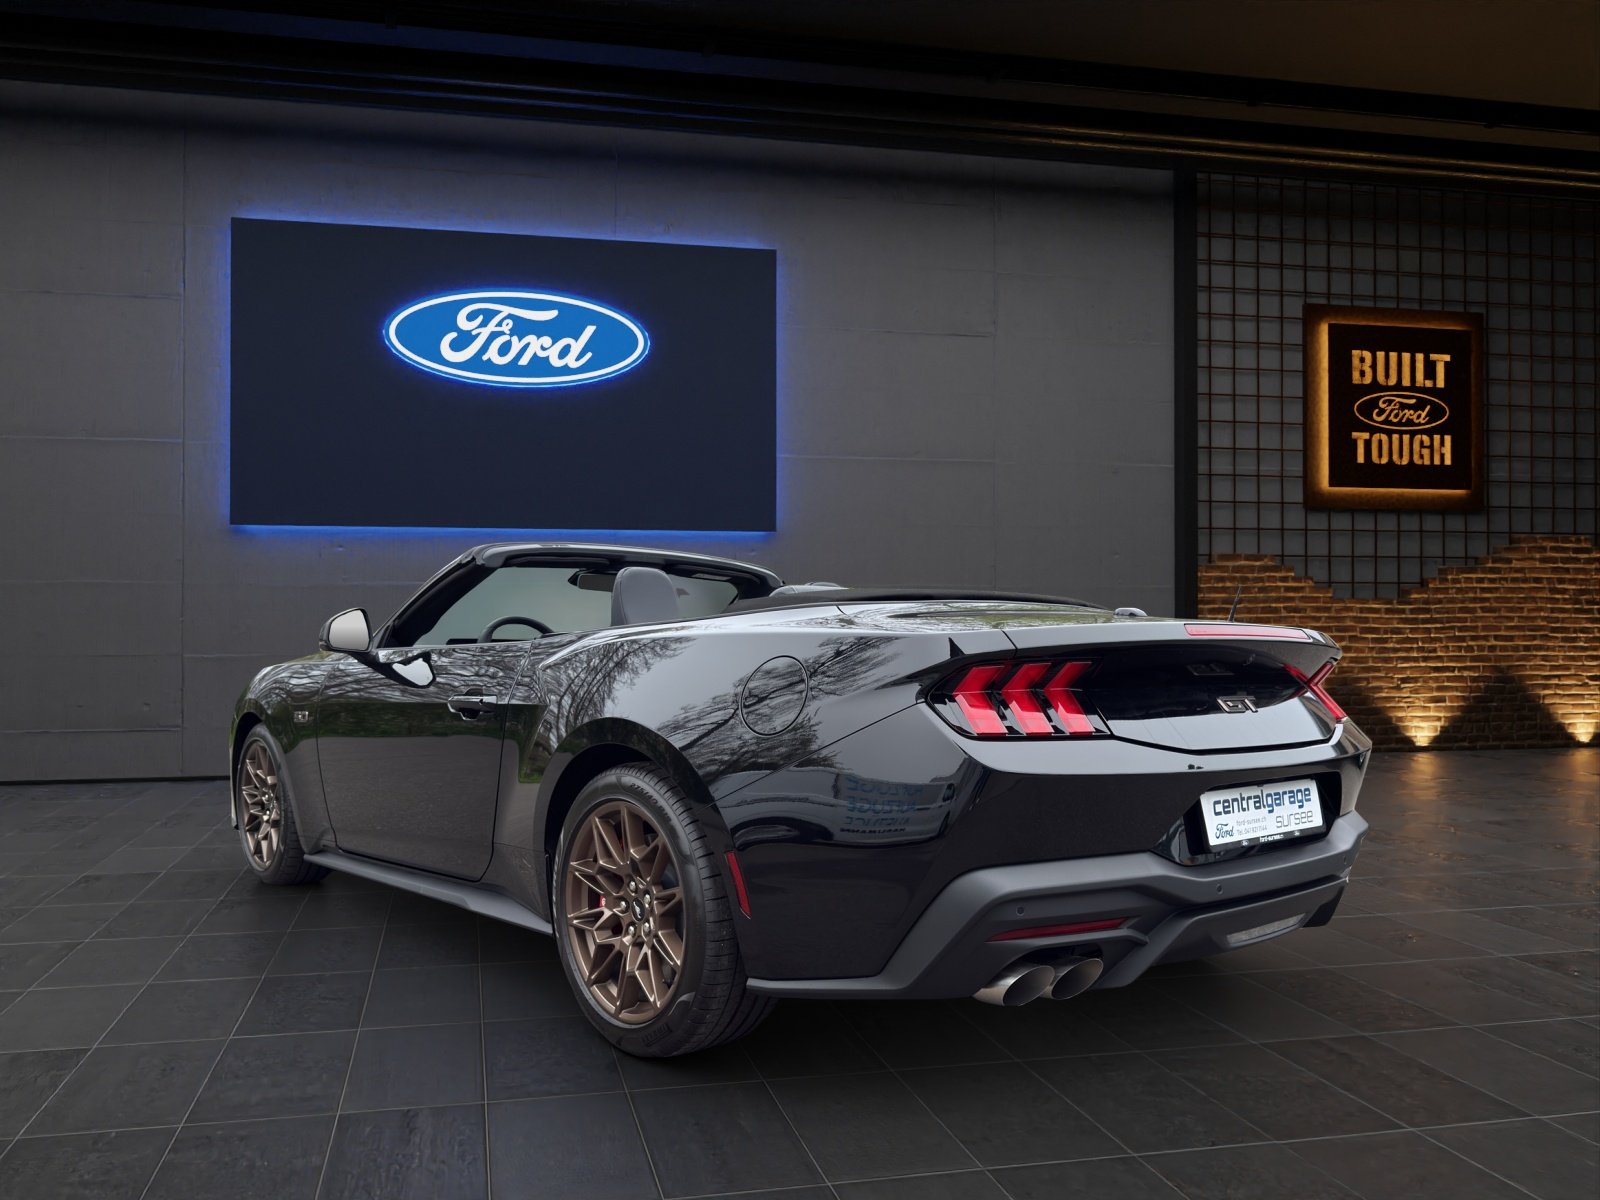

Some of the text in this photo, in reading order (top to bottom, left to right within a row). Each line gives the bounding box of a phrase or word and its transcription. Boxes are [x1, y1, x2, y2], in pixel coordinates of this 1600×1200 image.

[440, 302, 596, 368] Ford
[1351, 349, 1451, 388] BUILT
[1372, 396, 1430, 424] Ford
[1351, 431, 1452, 466] TOUGH
[1216, 695, 1258, 713] GT
[1212, 787, 1312, 816] centralgarage
[1215, 823, 1235, 839] Ford
[1275, 810, 1314, 829] sursee
